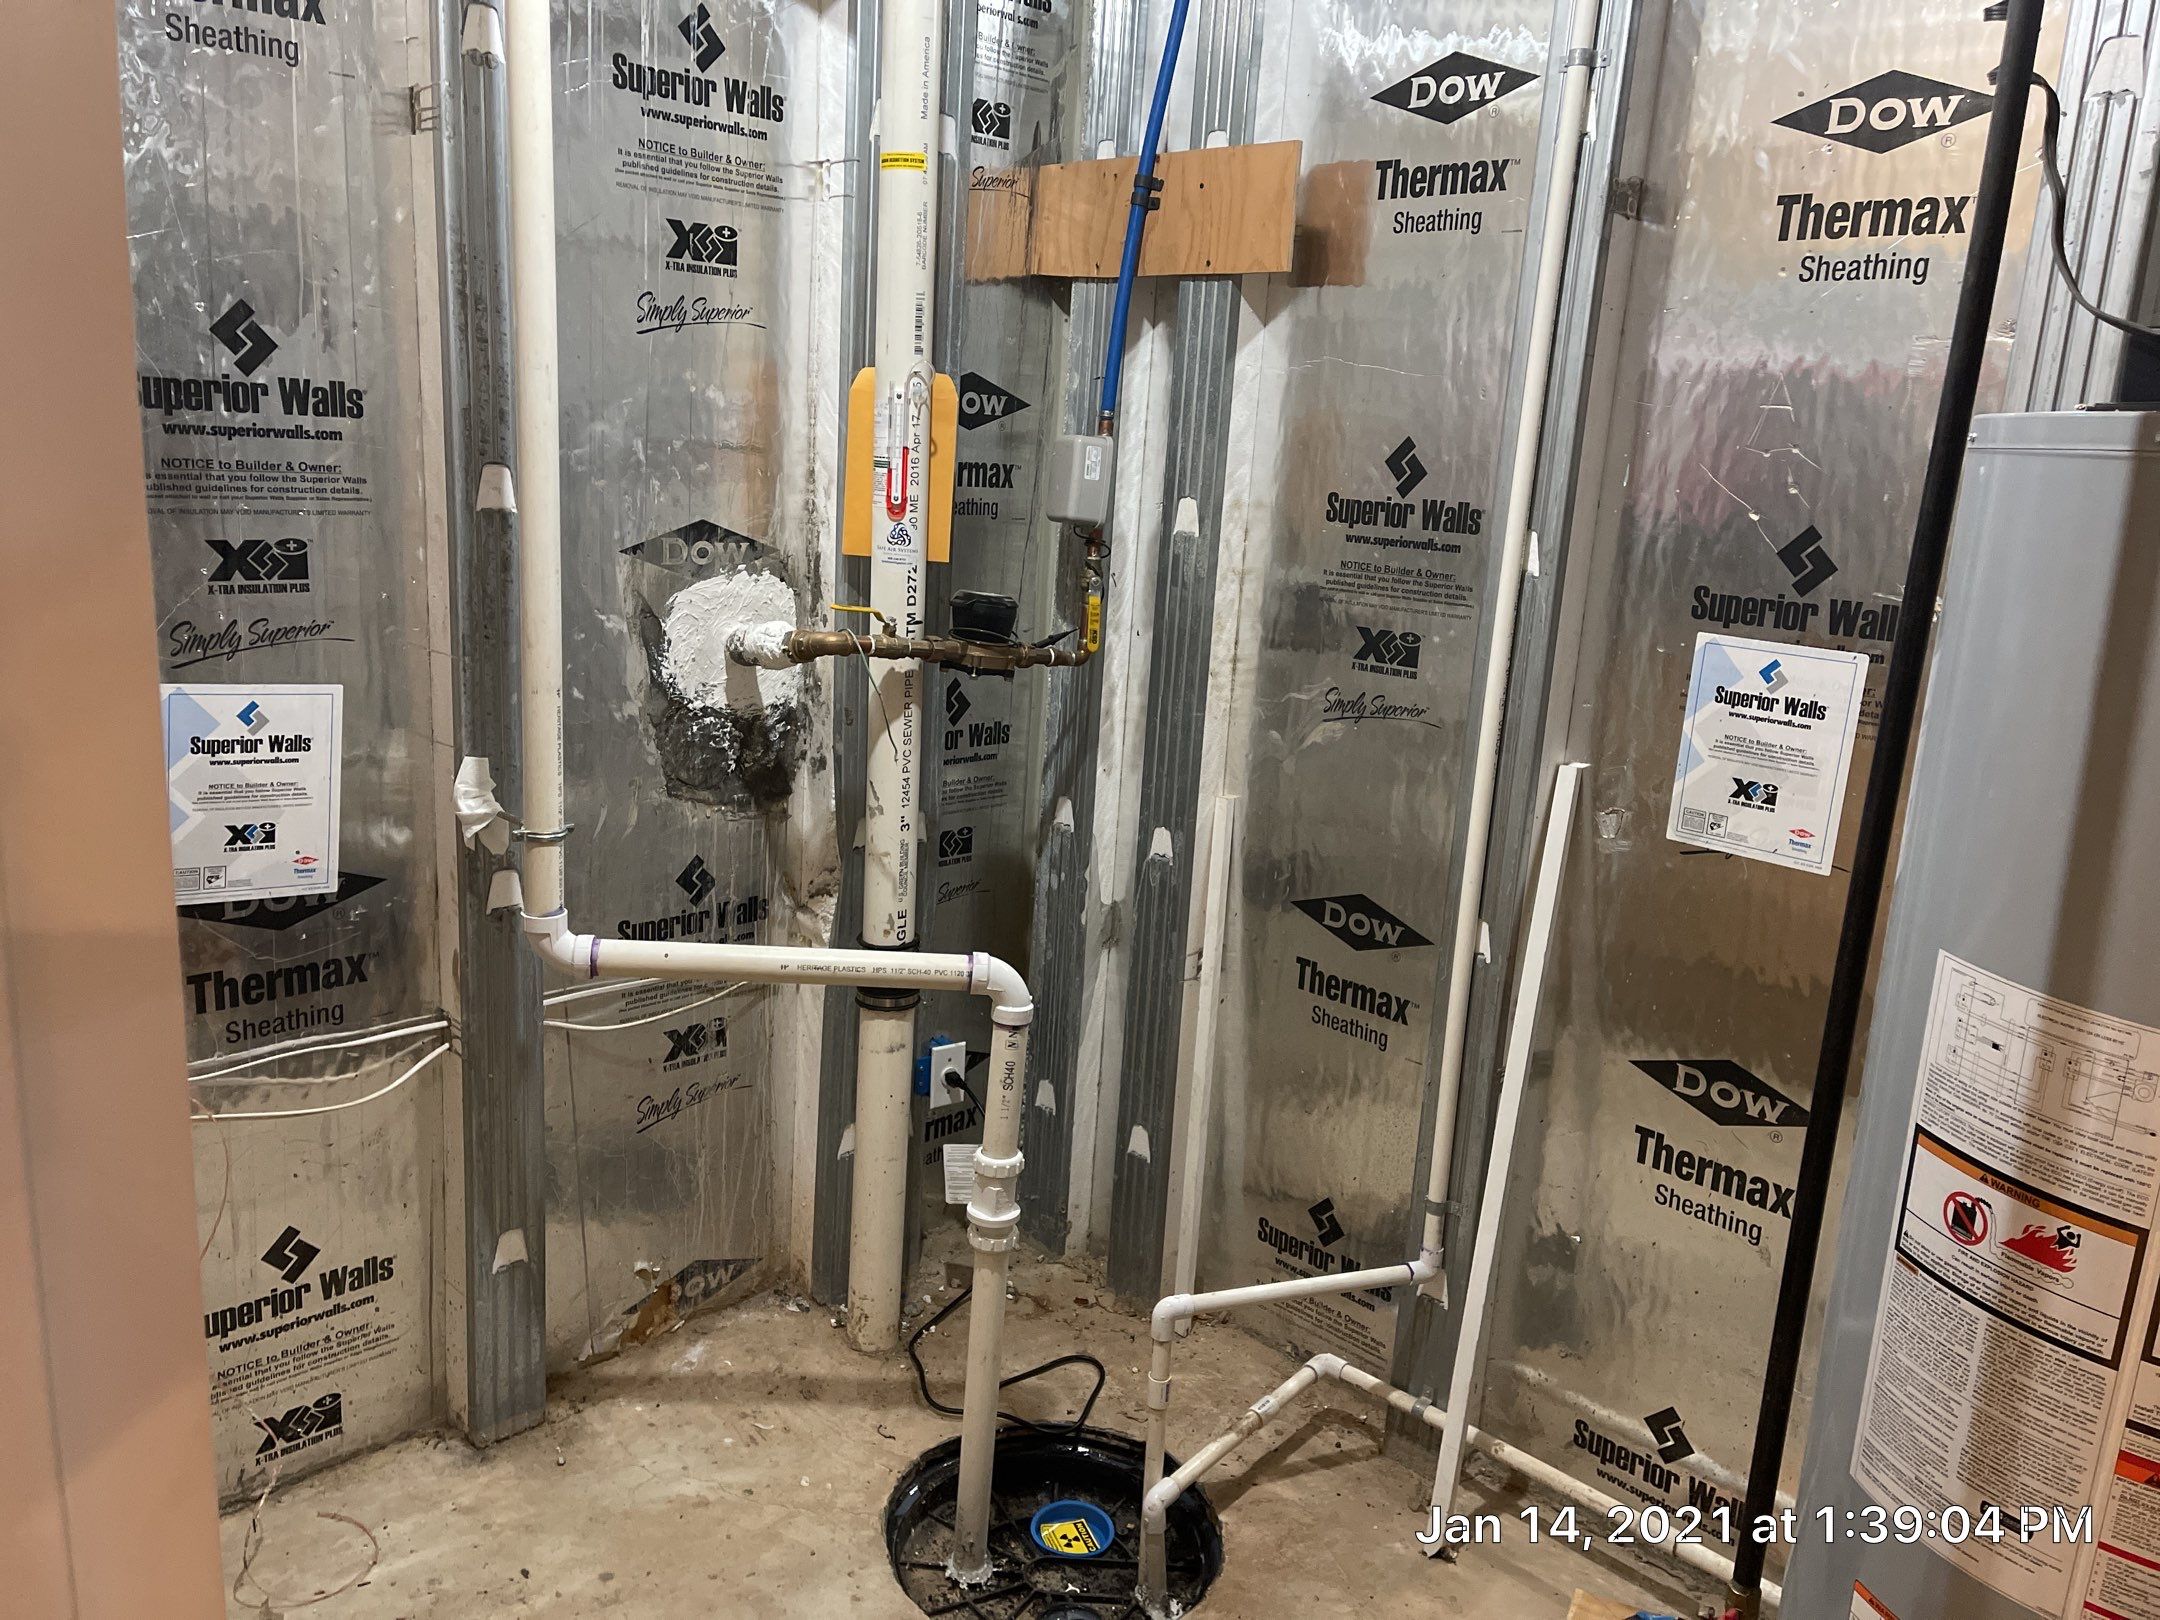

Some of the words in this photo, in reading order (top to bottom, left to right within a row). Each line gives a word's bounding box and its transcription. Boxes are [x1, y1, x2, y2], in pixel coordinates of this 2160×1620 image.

[165, 13, 299, 67] Sheathing
[922, 36, 931, 76] America
[612, 52, 717, 108] Superior
[724, 77, 785, 123] Walls
[923, 80, 929, 90] in
[1407, 71, 1505, 109] DOW
[921, 91, 929, 120] Made
[1824, 95, 1965, 135] DOW
[641, 106, 768, 141] www.superiorwalls.com
[638, 138, 676, 154] NOTICE
[678, 146, 688, 157] to
[690, 147, 723, 163] Builder
[726, 154, 733, 164] &
[734, 155, 766, 171] Owner:
[972, 166, 1018, 188] Superior
[1375, 159, 1510, 200] Thermax
[1393, 208, 1482, 235] Sheathing
[1777, 193, 1970, 241] Thermax
[665, 261, 685, 273] X-TRA
[687, 263, 721, 277] INSULATION
[723, 267, 738, 279] PLUS
[1799, 252, 1930, 285] Sheathing
[636, 291, 688, 332] Simply
[691, 297, 752, 324] Superior
[137, 371, 269, 414] uperior
[278, 377, 364, 419] Walls
[962, 391, 1008, 416] OW
[162, 422, 343, 442] www.superiorwalls.com
[911, 414, 920, 428] 17
[911, 432, 921, 453] Apr
[155, 473, 202, 482] essential
[205, 474, 226, 483] that
[228, 476, 248, 485] you
[249, 474, 279, 484] follow
[281, 475, 298, 484] the
[300, 475, 341, 487] Superior
[342, 476, 367, 486] Walls
[161, 458, 214, 470] NOTICE
[218, 460, 232, 471] to
[236, 459, 281, 471] Builder
[285, 461, 295, 471] &
[298, 461, 342, 473] Owner:
[910, 457, 919, 486] 2016
[957, 461, 1014, 489] rmax
[146, 483, 192, 493] ublished
[195, 484, 248, 495] guidelines
[250, 484, 264, 493] for
[267, 485, 327, 494] construction
[330, 486, 363, 495] details.
[909, 494, 919, 513] ME
[1326, 491, 1415, 529] Superior
[1422, 499, 1481, 535] Walls
[661, 537, 750, 565] DOW
[1345, 533, 1461, 554] www.superiorwalls.com
[906, 565, 917, 607] D272
[1340, 560, 1372, 573] NOTICE
[1373, 564, 1382, 573] to
[1384, 565, 1415, 577] Builder
[1417, 569, 1423, 577] &
[1425, 569, 1456, 582] Owner:
[208, 583, 236, 595] X-TRA
[238, 583, 288, 595] INSULATION
[290, 583, 310, 593] PLUS
[1691, 585, 1819, 632] Superior
[1829, 599, 1900, 642] Wall
[170, 619, 242, 660] Simply
[249, 618, 331, 648] Superior
[905, 670, 914, 698] PIPE
[1352, 661, 1368, 672] X-TRA
[1370, 664, 1402, 677] INSULATION
[1403, 670, 1418, 680] PLUS
[1323, 687, 1367, 724] Simply
[1370, 695, 1428, 718] Superior
[1714, 685, 1780, 713] Superior
[1785, 697, 1827, 721] Walls
[903, 701, 914, 746] SEWER
[969, 721, 1010, 750] Walls
[1729, 711, 1812, 731] www.superiorwalls.com
[190, 735, 264, 757] Superior
[268, 734, 312, 753] Walls
[1724, 734, 1747, 744] NOTICE
[1756, 739, 1778, 749] Builder
[209, 757, 299, 767] www.superiorwalls.com
[902, 749, 912, 774] PVC
[901, 777, 911, 808] 12454
[900, 815, 911, 832] 3"
[1789, 838, 1811, 849] Thermax
[937, 880, 980, 903] Superior
[897, 909, 907, 946] GLE
[1322, 900, 1406, 946] DOW
[187, 953, 368, 1014] Thermax
[797, 964, 831, 973] HERITAGE
[833, 965, 866, 974] PLASTICS
[907, 968, 931, 977] SCH-40
[934, 969, 948, 977] PVC
[950, 970, 965, 978] 1120
[1296, 956, 1411, 1026] Thermax
[226, 1003, 344, 1043] Sheathing
[1311, 1005, 1389, 1052] Sheathing
[1003, 1060, 1015, 1092] SCH40
[637, 1087, 683, 1125] Simply
[1673, 1063, 1790, 1124] DOW
[924, 1106, 979, 1143] rmax
[1635, 1124, 1796, 1220] Thermax
[1990, 1180, 2041, 1208] WARNING
[1654, 1183, 1762, 1246] Sheathing
[1257, 1217, 1334, 1273] Superior
[1958, 1248, 1969, 1257] FIRE
[1980, 1260, 2010, 1282] EXPLOSION
[2011, 1276, 2035, 1292] HAZARD
[2001, 1251, 2035, 1272] Flammable
[2036, 1267, 2060, 1283] Vapors
[204, 1282, 311, 1338] uperior
[319, 1255, 394, 1301] Walls
[219, 1295, 374, 1353] www.superiorwalls.com
[1573, 1418, 1681, 1495] Superior
[1689, 1476, 1746, 1532] Wall
[1076, 1522, 1097, 1553] CAUTION
